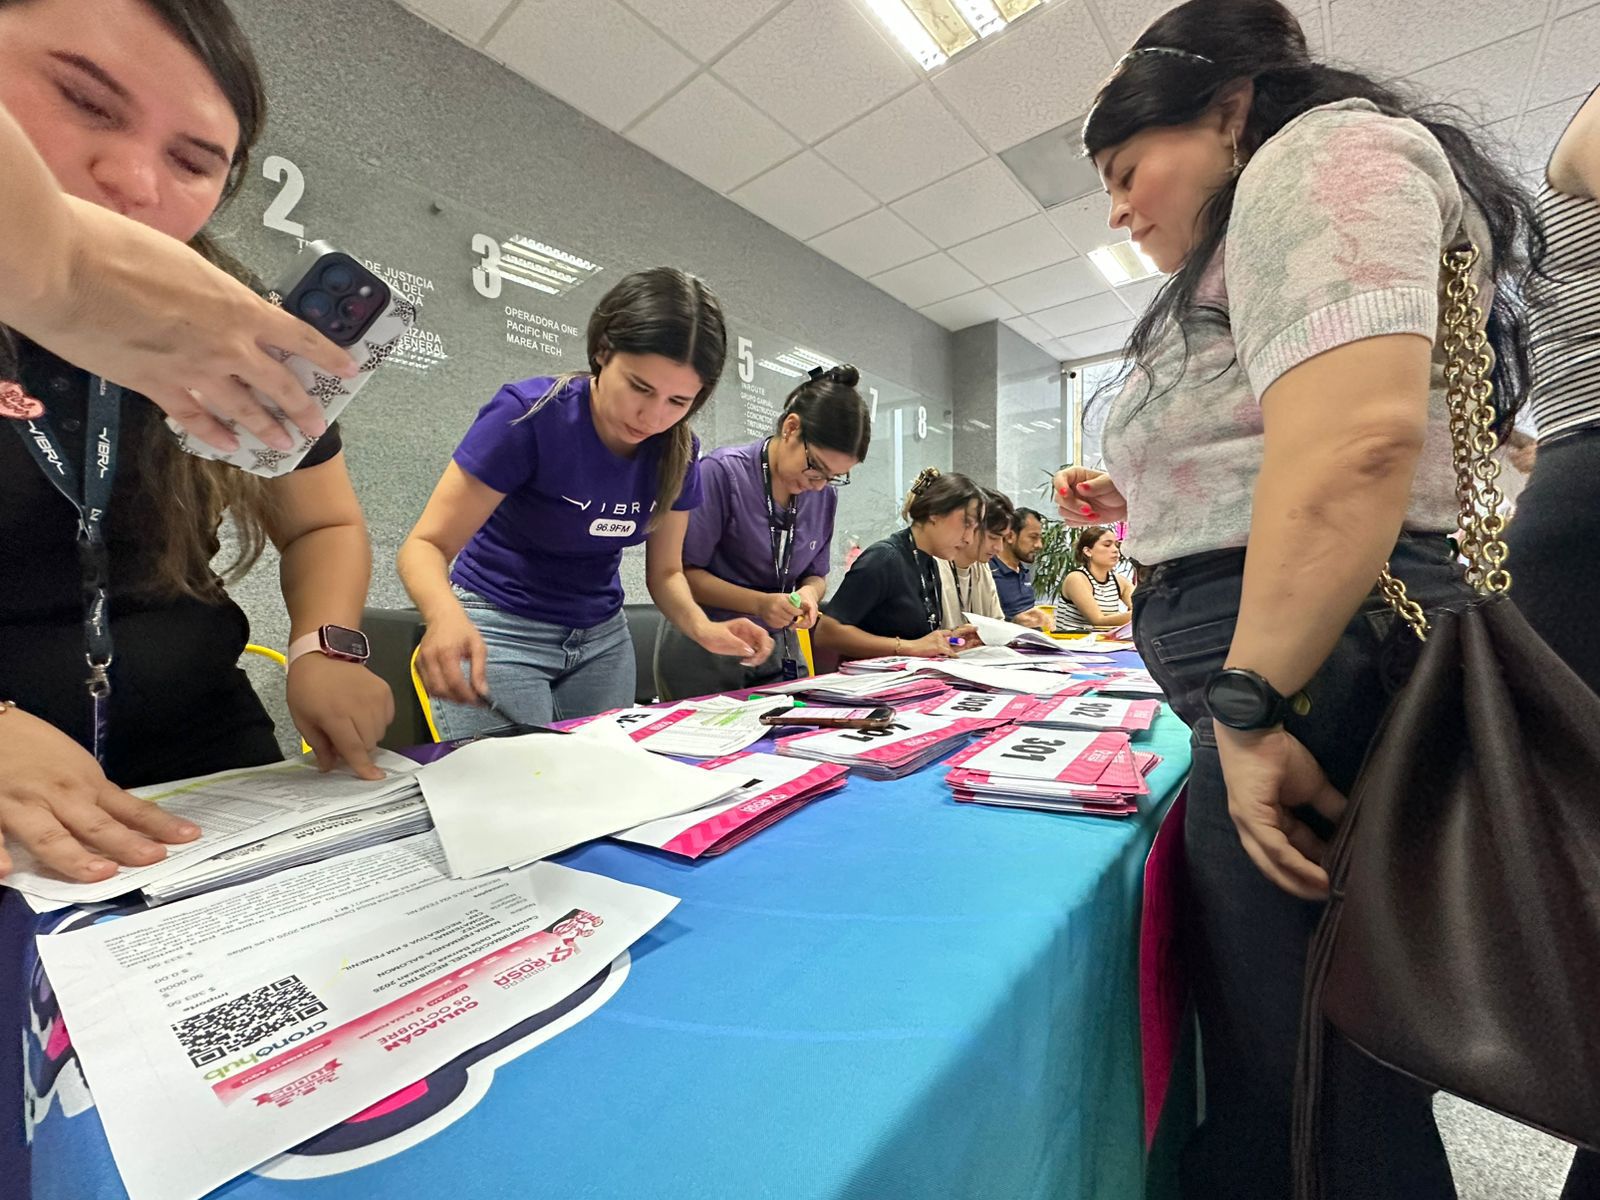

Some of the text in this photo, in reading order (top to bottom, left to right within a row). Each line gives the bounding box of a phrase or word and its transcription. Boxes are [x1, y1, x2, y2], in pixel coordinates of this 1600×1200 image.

[263, 155, 305, 237] 2
[364, 260, 381, 273] DE
[384, 267, 434, 291] JUSTICIA
[471, 233, 501, 299] 3
[403, 282, 424, 297] DEL
[504, 306, 578, 337] OPERADORA ONE
[506, 320, 560, 343] PACIFIC NET
[506, 333, 562, 357] MAREA TECH
[737, 336, 754, 383] 5
[869, 387, 879, 424] 7
[917, 405, 928, 440] 8
[28, 420, 65, 475] VIBRA
[97, 427, 111, 479] VIBRA
[595, 523, 631, 533] 96.9FM
[1070, 702, 1113, 718] 902
[1000, 737, 1066, 762] 301
[409, 920, 462, 945] RECREATIVA
[341, 953, 385, 971] FEMENIL
[372, 915, 539, 993] Carrera Rosa Dalia Barraza Culiacán 2025
[385, 946, 402, 955] KM
[399, 924, 530, 988] CONFIRMACIÓN DEL REGISTRO
[494, 958, 546, 986] ROSA
[182, 991, 229, 1012] Importe
[378, 995, 471, 1045] 05 OCTUBRE
[384, 1001, 478, 1051] CULIACÁN
[204, 1021, 327, 1080] cronohub
[270, 1066, 330, 1102] TODOS
